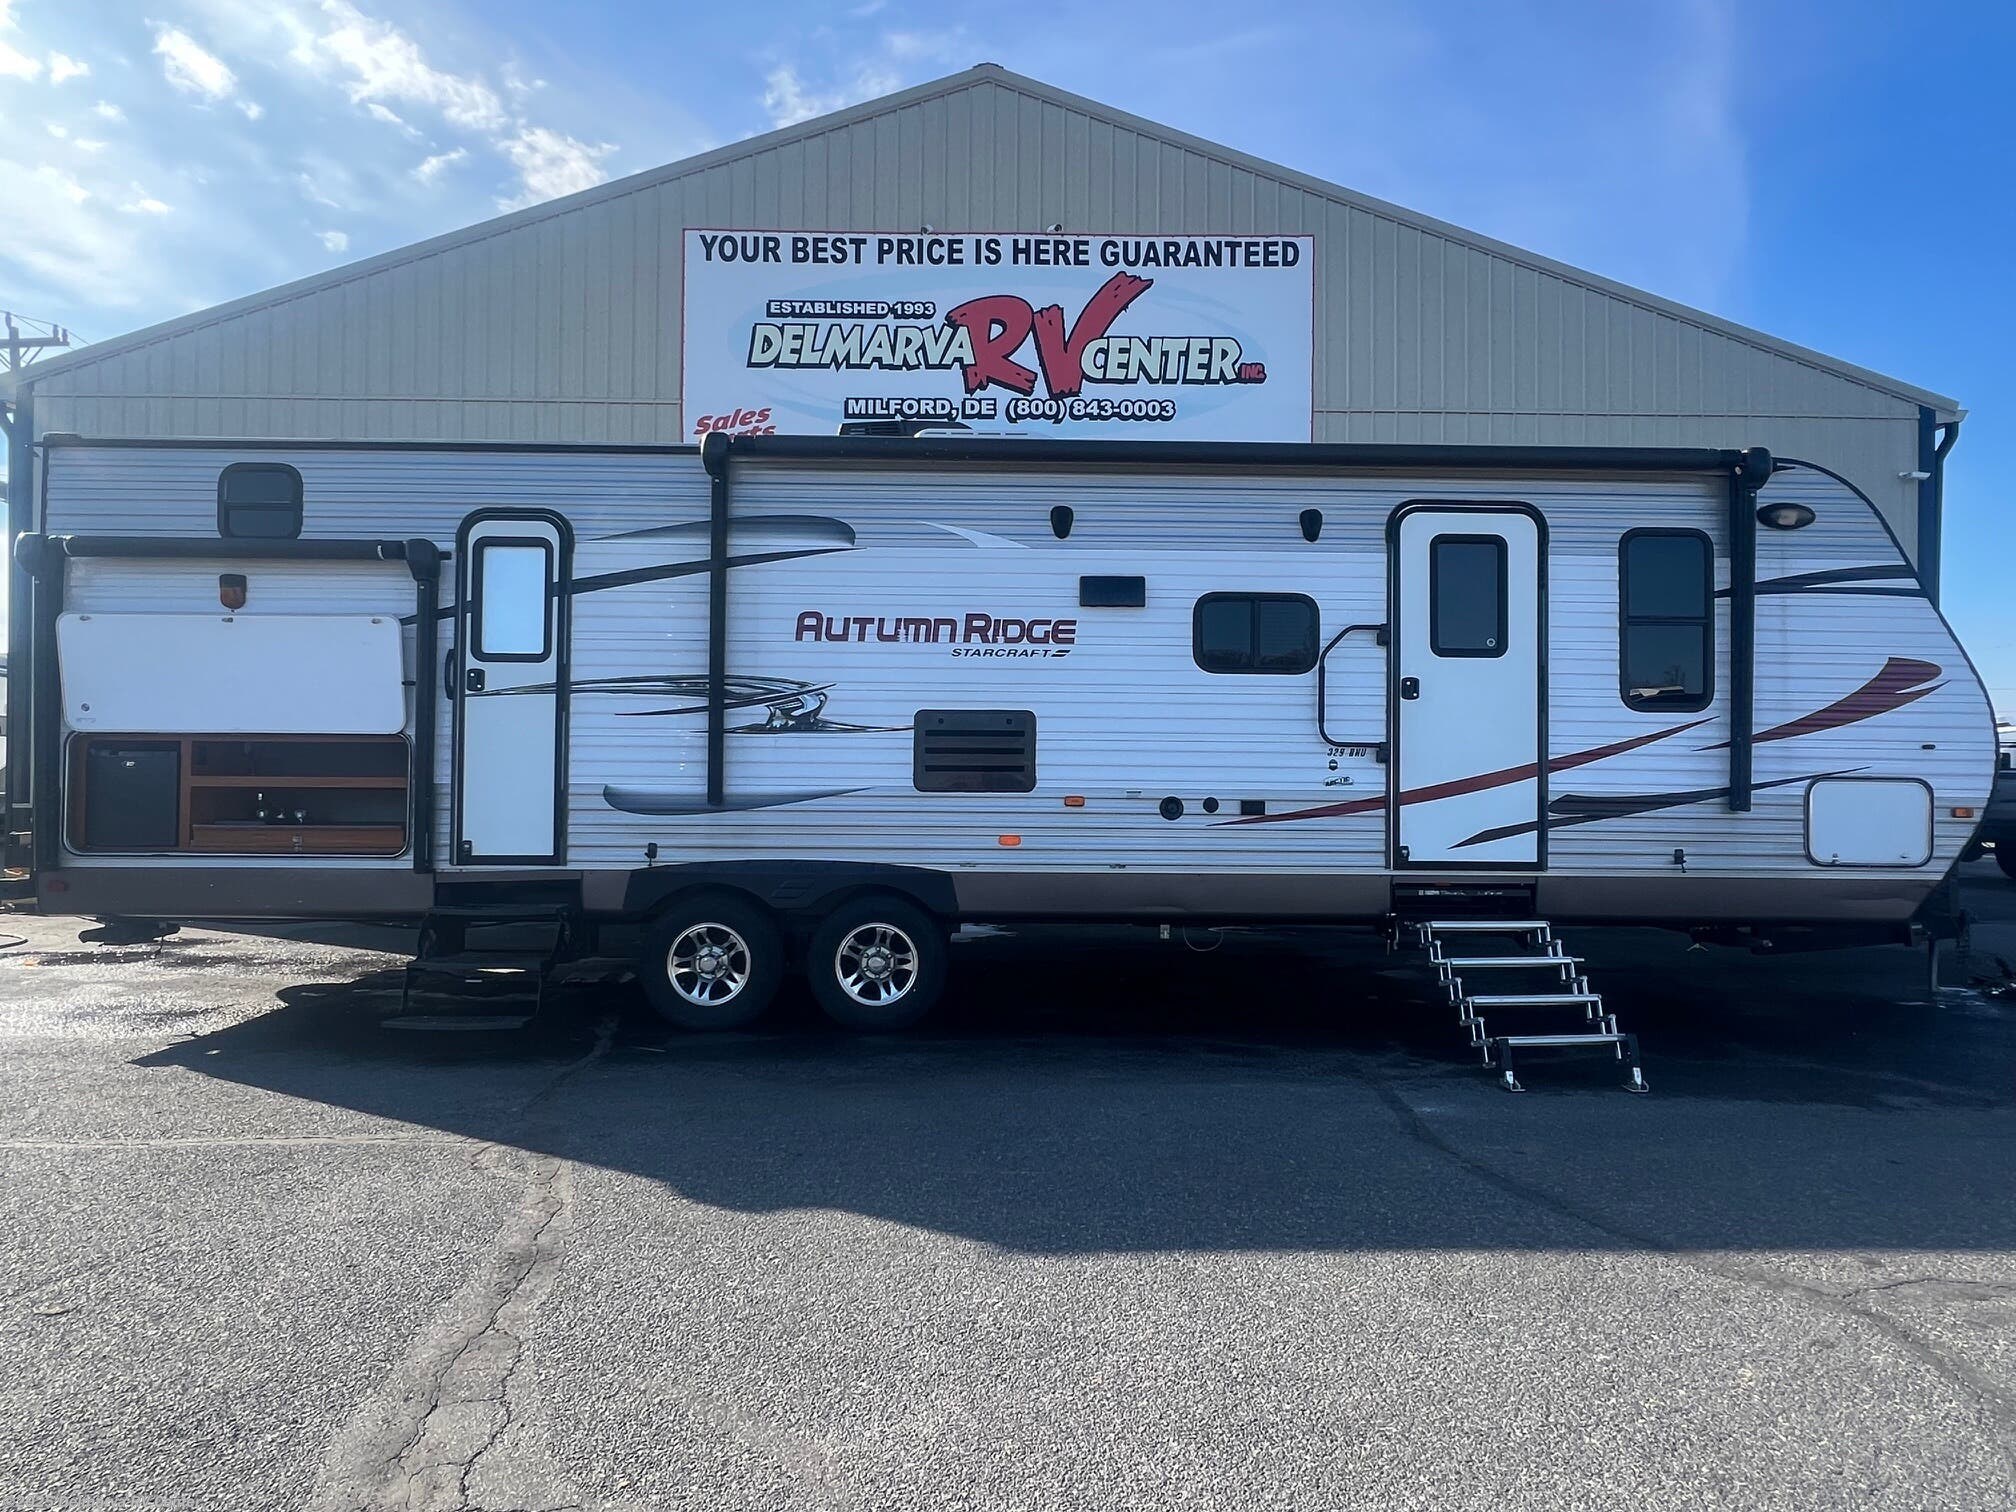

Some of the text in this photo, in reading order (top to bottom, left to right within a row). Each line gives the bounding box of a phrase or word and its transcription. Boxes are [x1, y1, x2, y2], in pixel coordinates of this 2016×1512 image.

[699, 234, 1300, 268] YOUR BEST PRICE IS HERE GUARANTEED
[768, 301, 936, 317] ESTABLISHED 1993
[748, 324, 976, 370] DELMARVA
[946, 271, 1154, 399] RV
[1081, 336, 1242, 383] CENTER
[693, 407, 772, 435] Sales
[845, 399, 1177, 423] MILFORD, DE (800) 843-0003
[795, 611, 1077, 645] AUTUMN RIDGE
[951, 648, 1052, 658] STARCRAFT
[1327, 748, 1345, 757] 329
